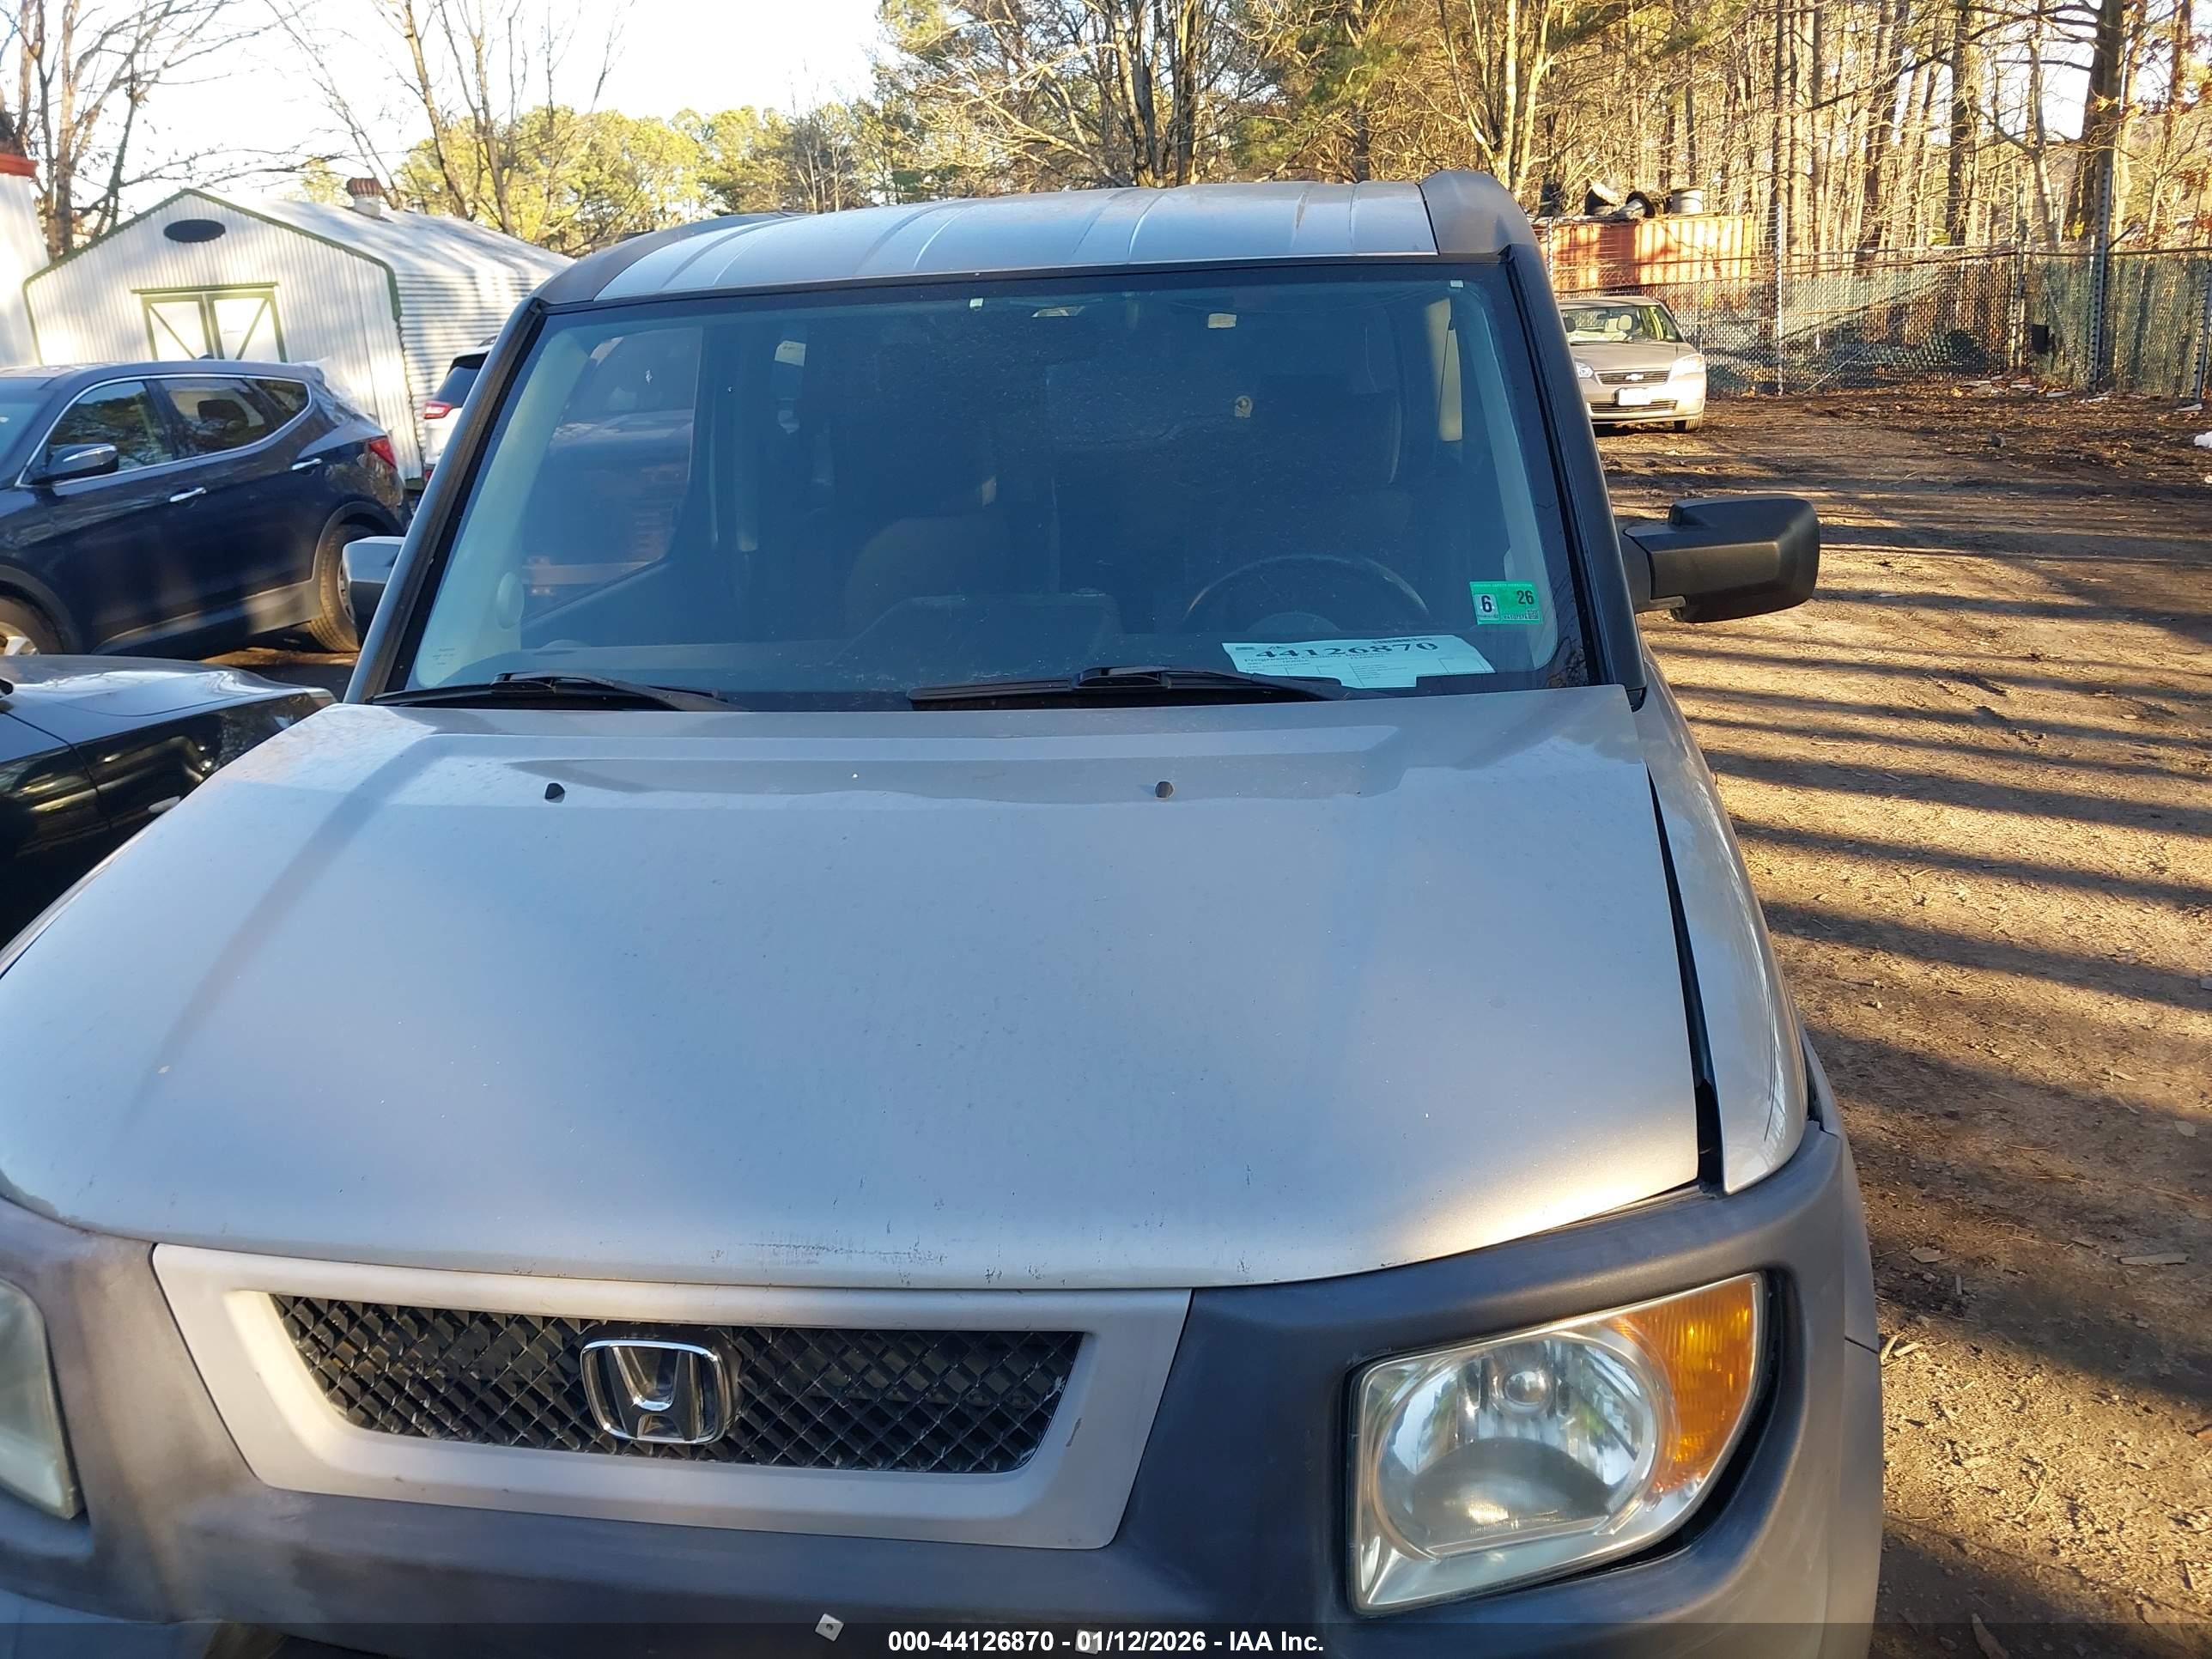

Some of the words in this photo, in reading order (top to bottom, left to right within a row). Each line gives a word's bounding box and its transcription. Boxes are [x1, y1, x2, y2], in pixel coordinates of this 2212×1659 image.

[1480, 595, 1492, 612] 6
[1516, 590, 1534, 605] 26
[1255, 642, 1438, 658] 44126870
